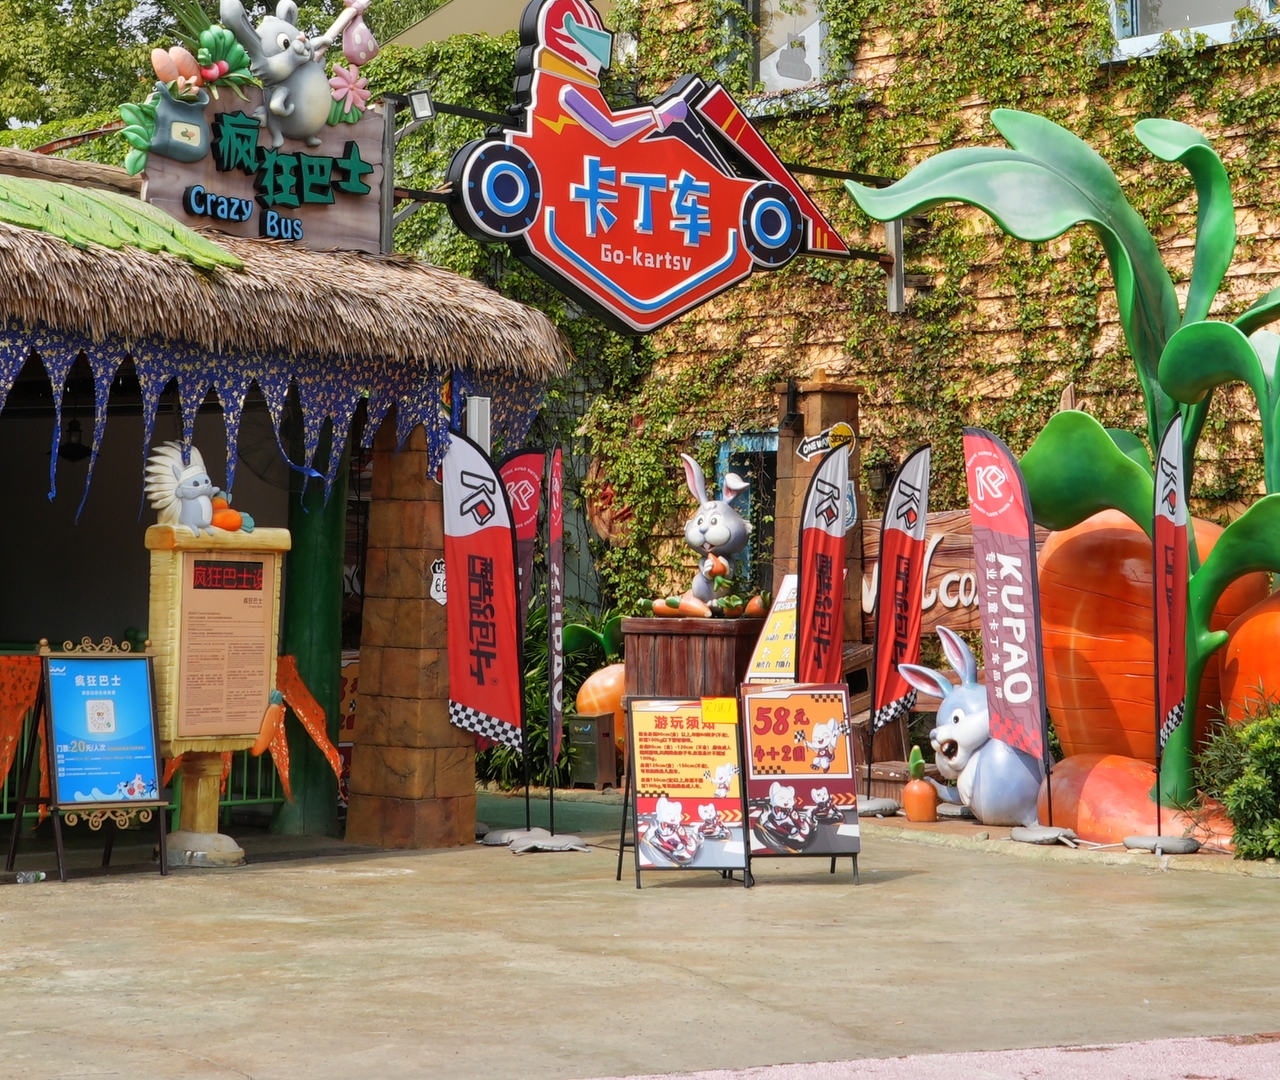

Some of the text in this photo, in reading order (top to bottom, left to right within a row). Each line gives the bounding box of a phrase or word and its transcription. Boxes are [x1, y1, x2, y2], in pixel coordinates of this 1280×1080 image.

[215, 111, 374, 208] 疯狂巴士
[189, 184, 304, 240] Crazy Bus
[569, 155, 712, 248] 卡丁车
[600, 244, 693, 272] Go-kartsv
[803, 442, 817, 454] ONE
[984, 551, 1003, 700] 专业儿童卡丁车品牌
[996, 552, 1033, 704] KUPAO
[75, 675, 121, 687] 疯狂巴士
[753, 707, 810, 736] 58元
